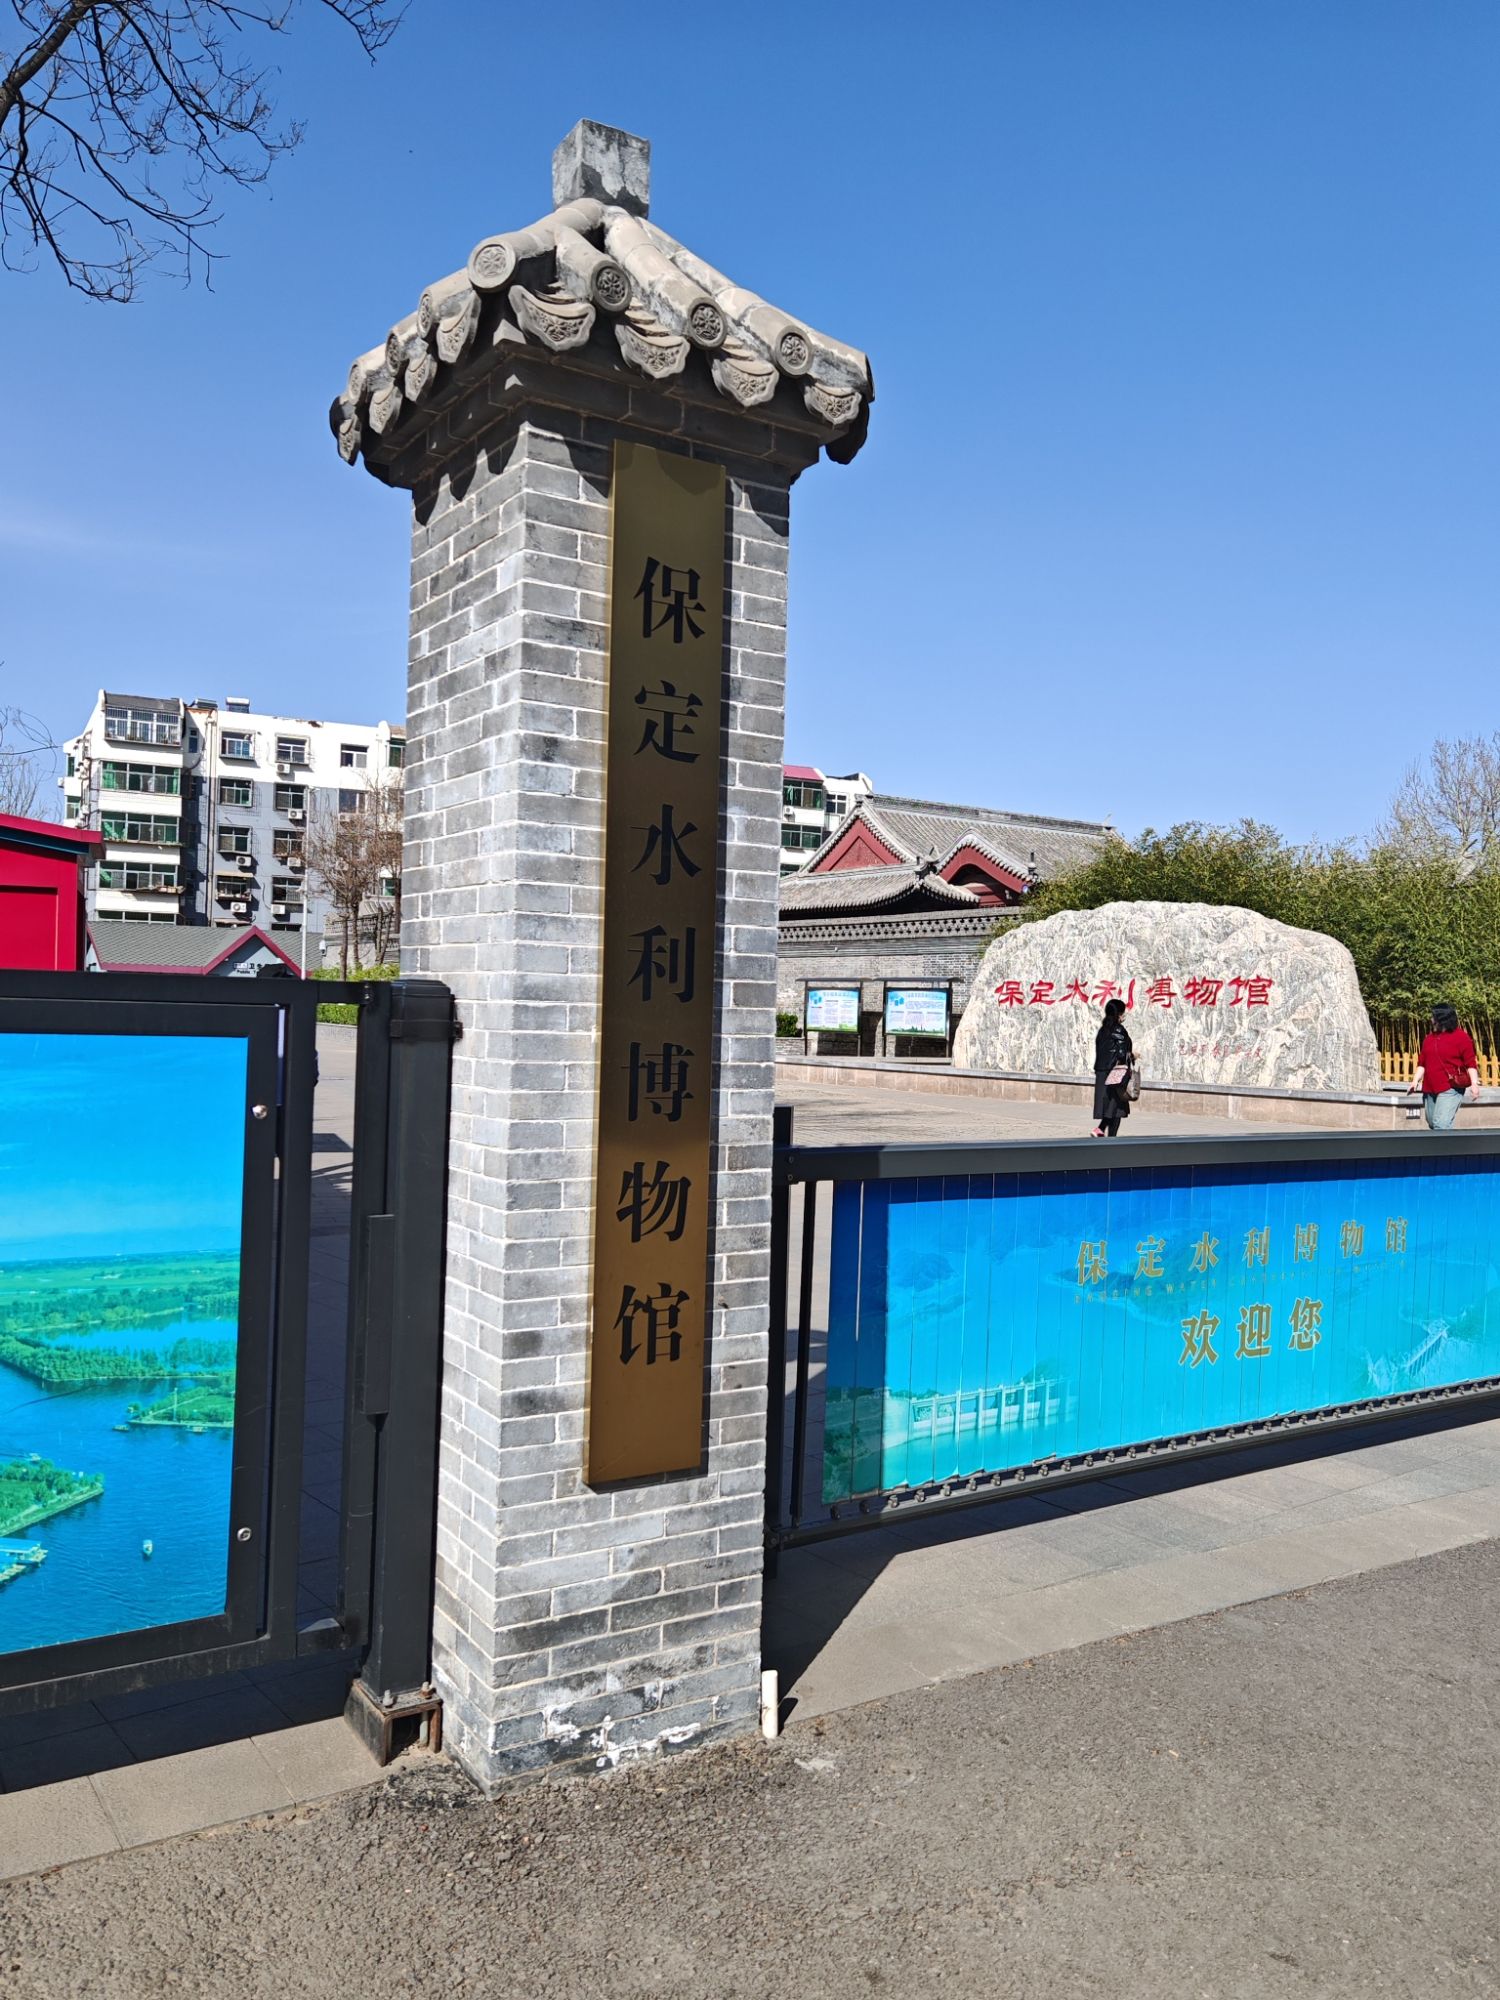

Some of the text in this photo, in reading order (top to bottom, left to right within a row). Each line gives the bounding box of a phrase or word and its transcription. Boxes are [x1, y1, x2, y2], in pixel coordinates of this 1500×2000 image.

[613, 556, 707, 1366] 保定水利博物馆
[994, 974, 1274, 1010] 保定水利博物馆
[1075, 1215, 1408, 1287] 保定水利博物馆
[1178, 1297, 1323, 1369] 欢迎您
